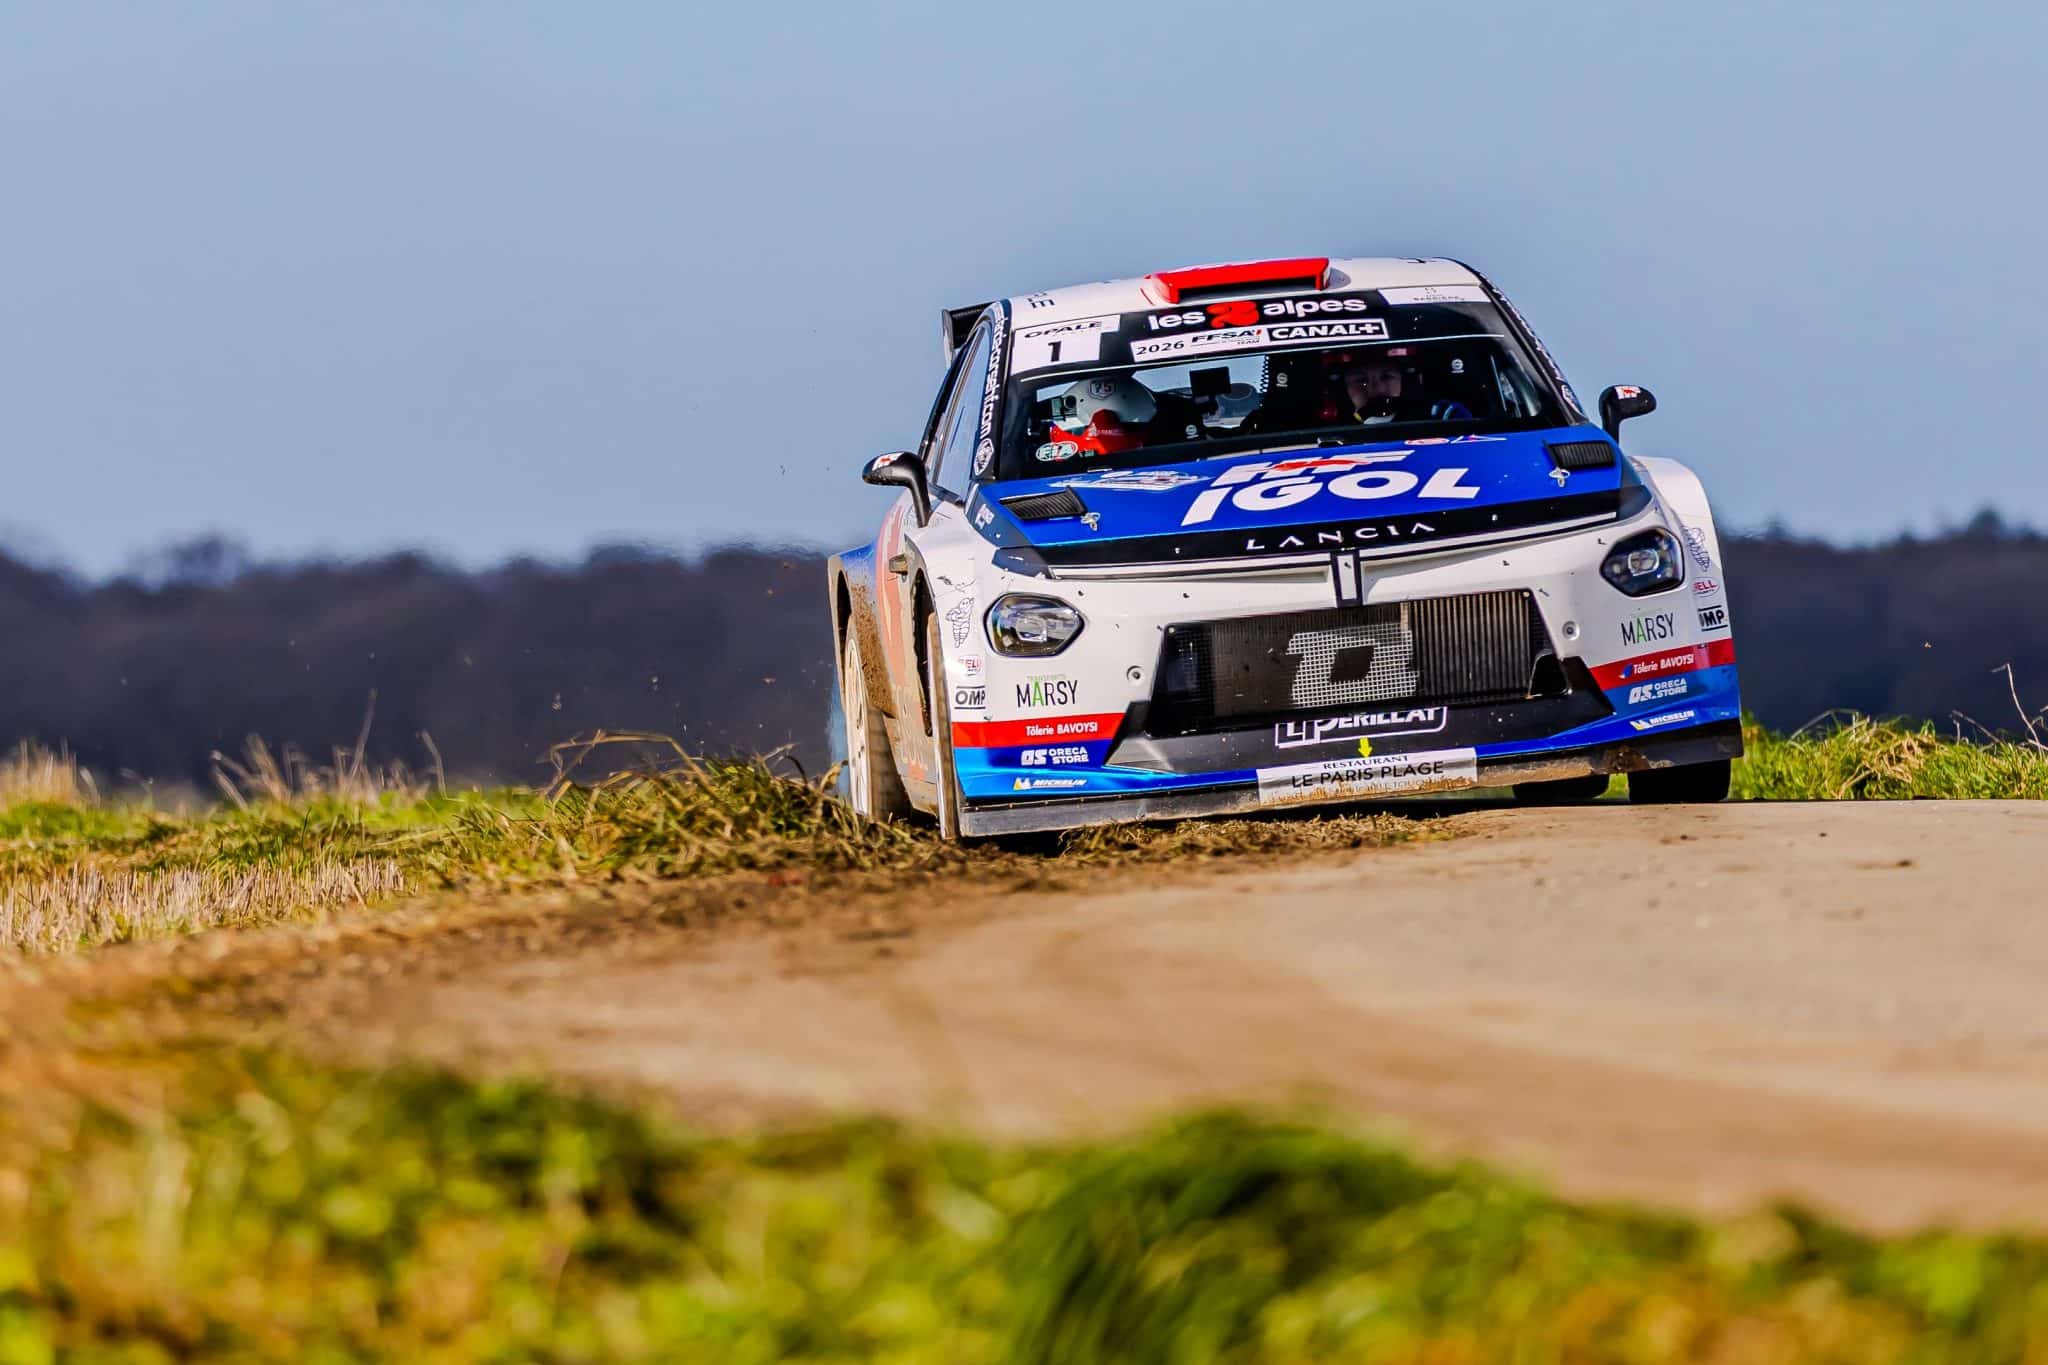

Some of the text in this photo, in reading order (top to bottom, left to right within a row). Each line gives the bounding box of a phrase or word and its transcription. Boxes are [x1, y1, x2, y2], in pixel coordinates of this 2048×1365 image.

[1149, 311, 1206, 331] les
[1263, 299, 1368, 318] alpes
[1024, 321, 1102, 338] OPALE
[1136, 340, 1185, 356] 2026
[1271, 318, 1381, 341] CANAL+
[1048, 341, 1062, 363] 1
[1180, 460, 1481, 527] IGOL
[1246, 522, 1437, 550] LANCIA
[1620, 612, 1674, 646] MARSY
[1016, 679, 1078, 708] MARSY
[1654, 678, 1688, 690] ORECA
[1649, 710, 1695, 725] MICHELIN
[1025, 724, 1054, 736] Tôlerie
[1049, 747, 1088, 756] ORECA
[1323, 755, 1409, 770] RESTAURANT
[1291, 761, 1444, 788] LE PARIS PLAGE
